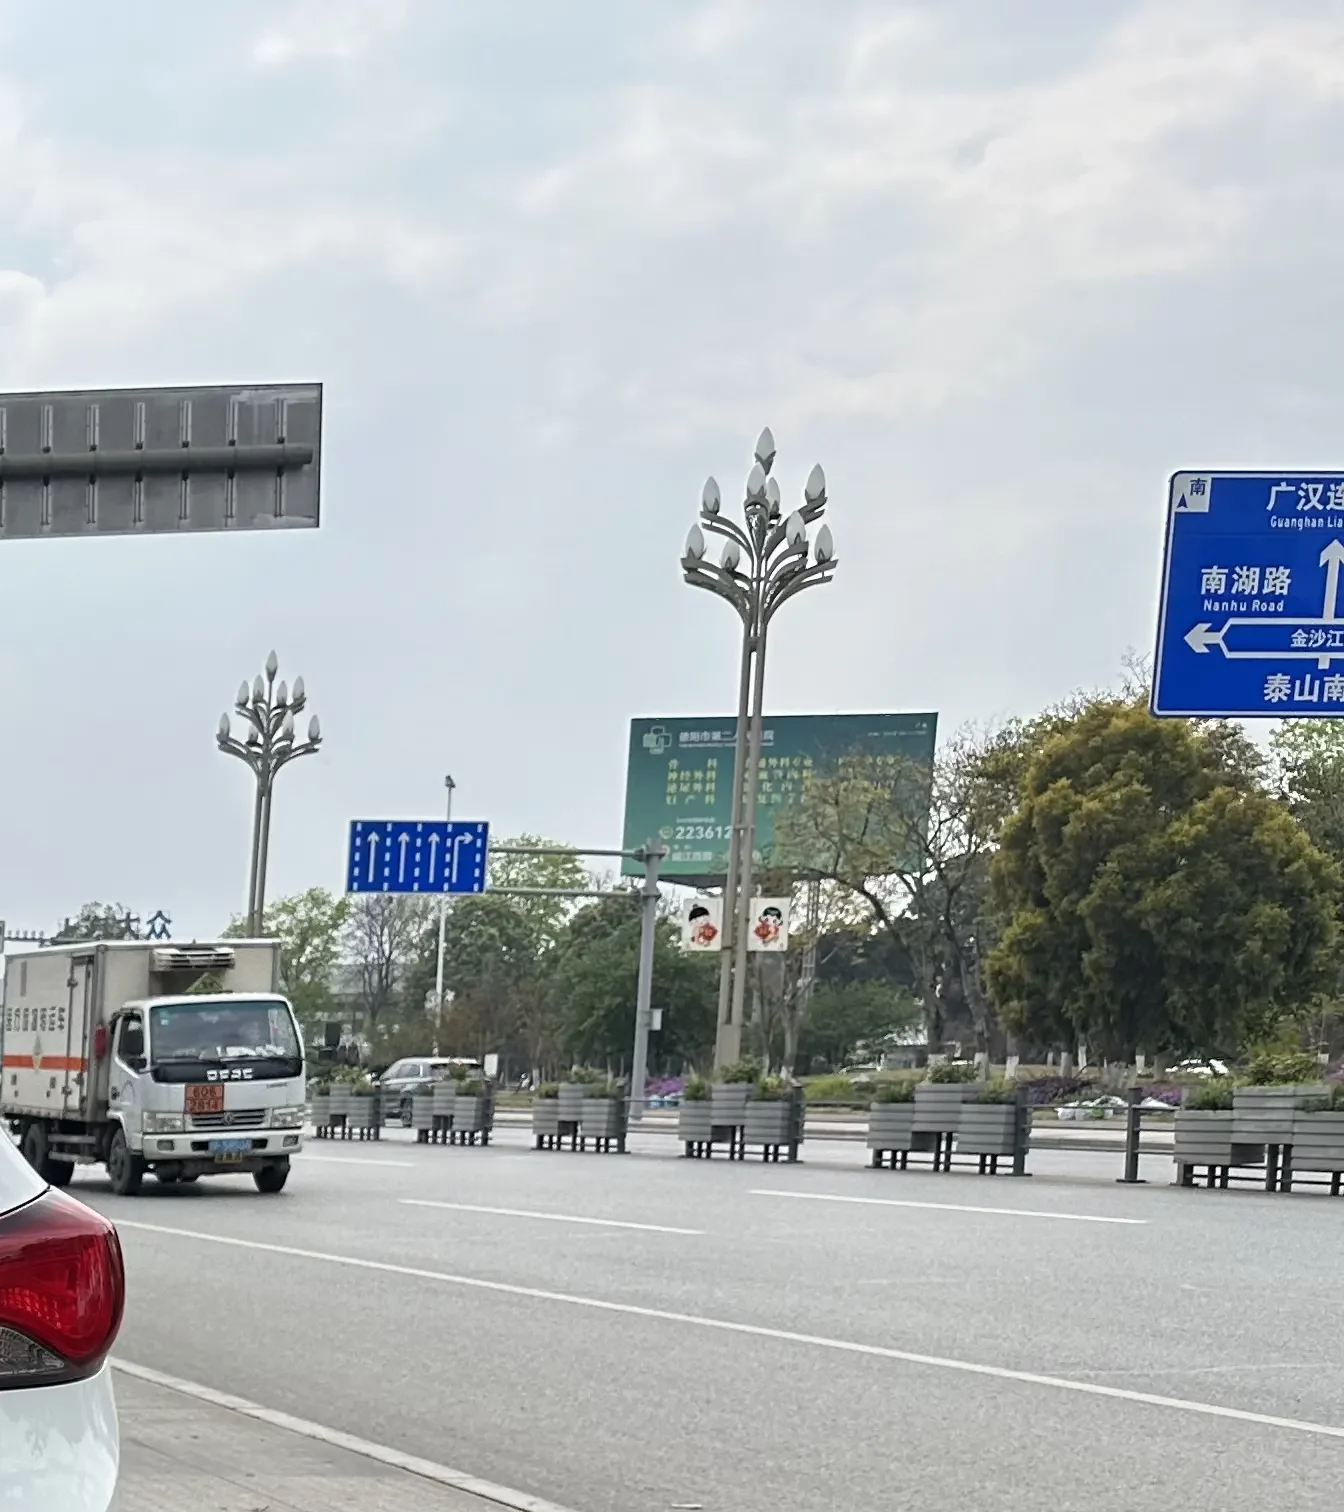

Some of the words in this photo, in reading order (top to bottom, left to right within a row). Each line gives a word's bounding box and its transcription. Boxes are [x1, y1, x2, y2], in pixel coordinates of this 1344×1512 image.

[1189, 477, 1208, 496] 南
[1270, 515, 1324, 530] Guanghan
[1201, 565, 1292, 595] 南湖路
[1203, 599, 1247, 612] Nanhu
[1252, 600, 1284, 612] Road
[1290, 629, 1344, 648] 金沙江
[1264, 673, 1344, 703] 泰山南
